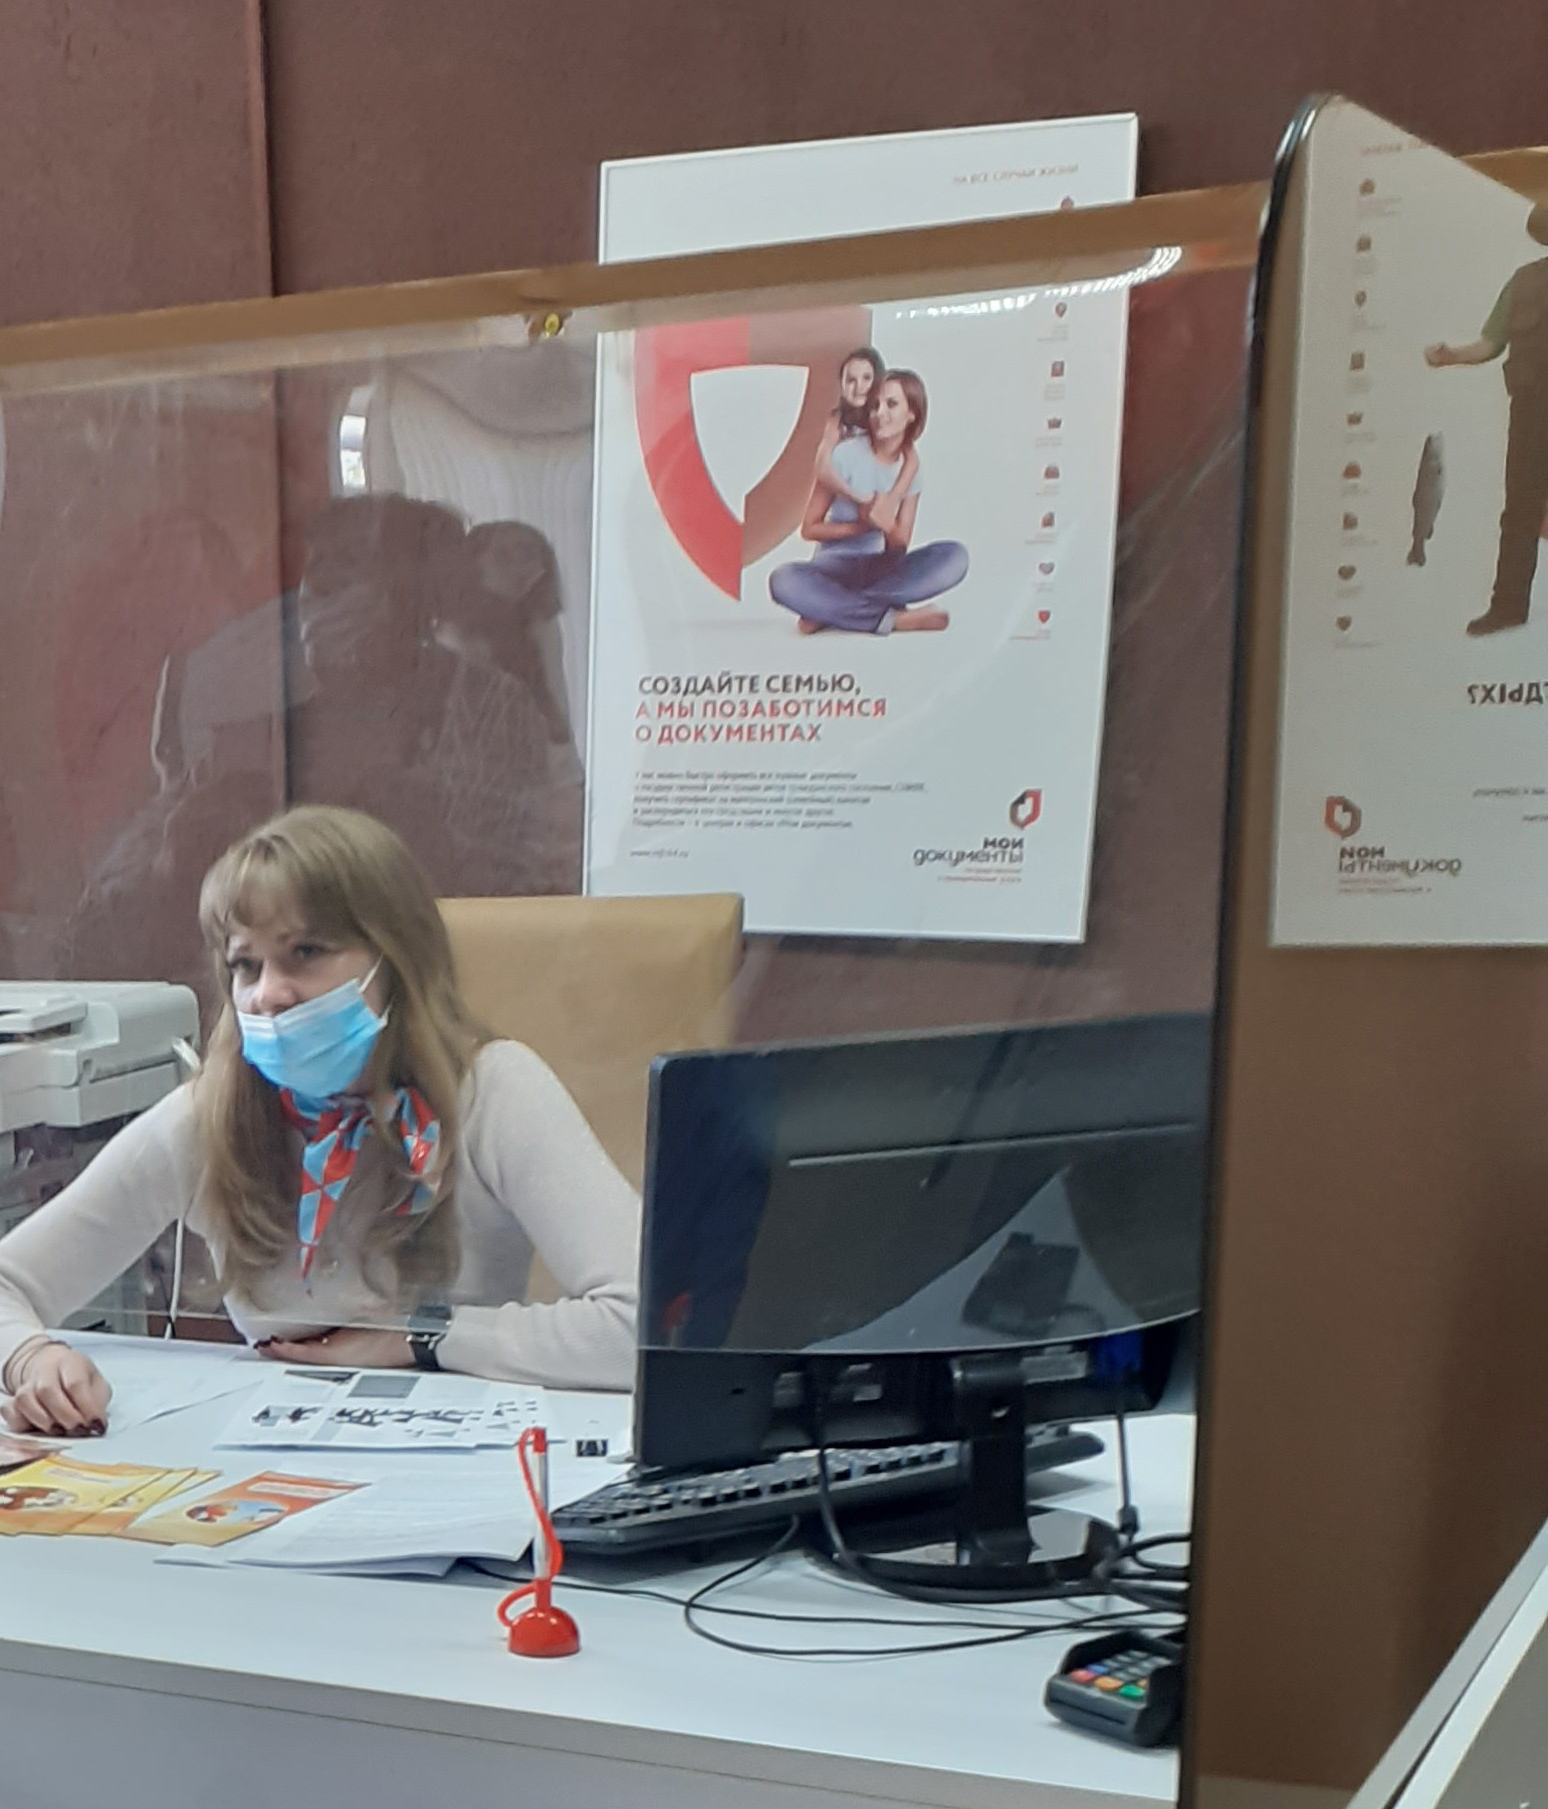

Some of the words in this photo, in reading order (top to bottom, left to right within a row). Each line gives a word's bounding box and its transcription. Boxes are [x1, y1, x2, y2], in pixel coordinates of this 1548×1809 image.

[638, 670, 760, 696] СОЗДАЙТЕ
[764, 673, 861, 696] СЕМЬЮ,
[636, 701, 651, 719] А
[656, 701, 695, 719] МЫ
[702, 698, 888, 718] ПОЗАБОТИМСЯ
[636, 724, 652, 742] О
[657, 722, 822, 745] ДОКУМЕНТАХ
[983, 837, 1025, 850] мои
[913, 848, 1024, 867] документы
